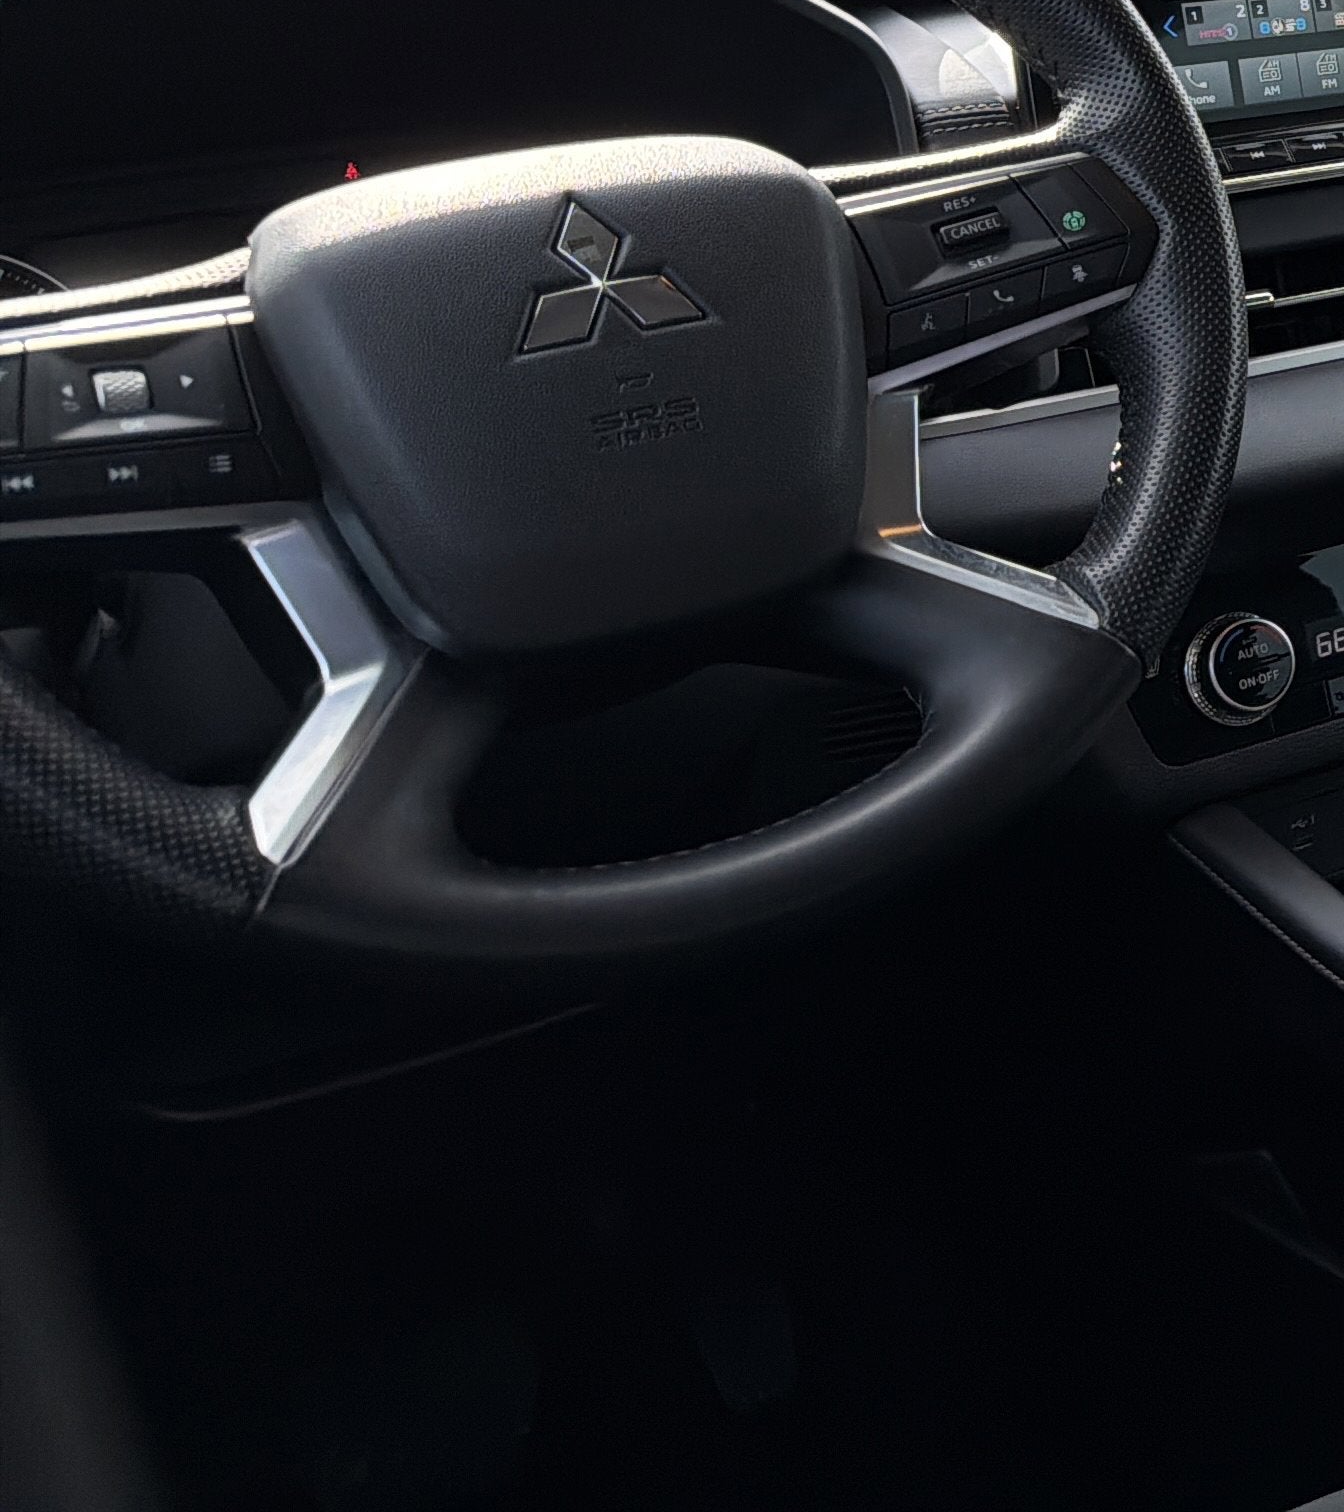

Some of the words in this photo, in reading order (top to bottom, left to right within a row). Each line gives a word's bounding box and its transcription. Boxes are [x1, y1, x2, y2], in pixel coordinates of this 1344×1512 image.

[1235, 3, 1247, 19] 2
[1256, 4, 1265, 16] 2
[1263, 85, 1281, 96] AM
[1321, 78, 1338, 89] FM
[1188, 93, 1217, 106] hone
[943, 196, 977, 212] RES+
[950, 217, 1001, 240] CANCEL
[968, 254, 999, 269] SET-
[590, 396, 700, 432] SRS
[1237, 642, 1269, 661] AUTO
